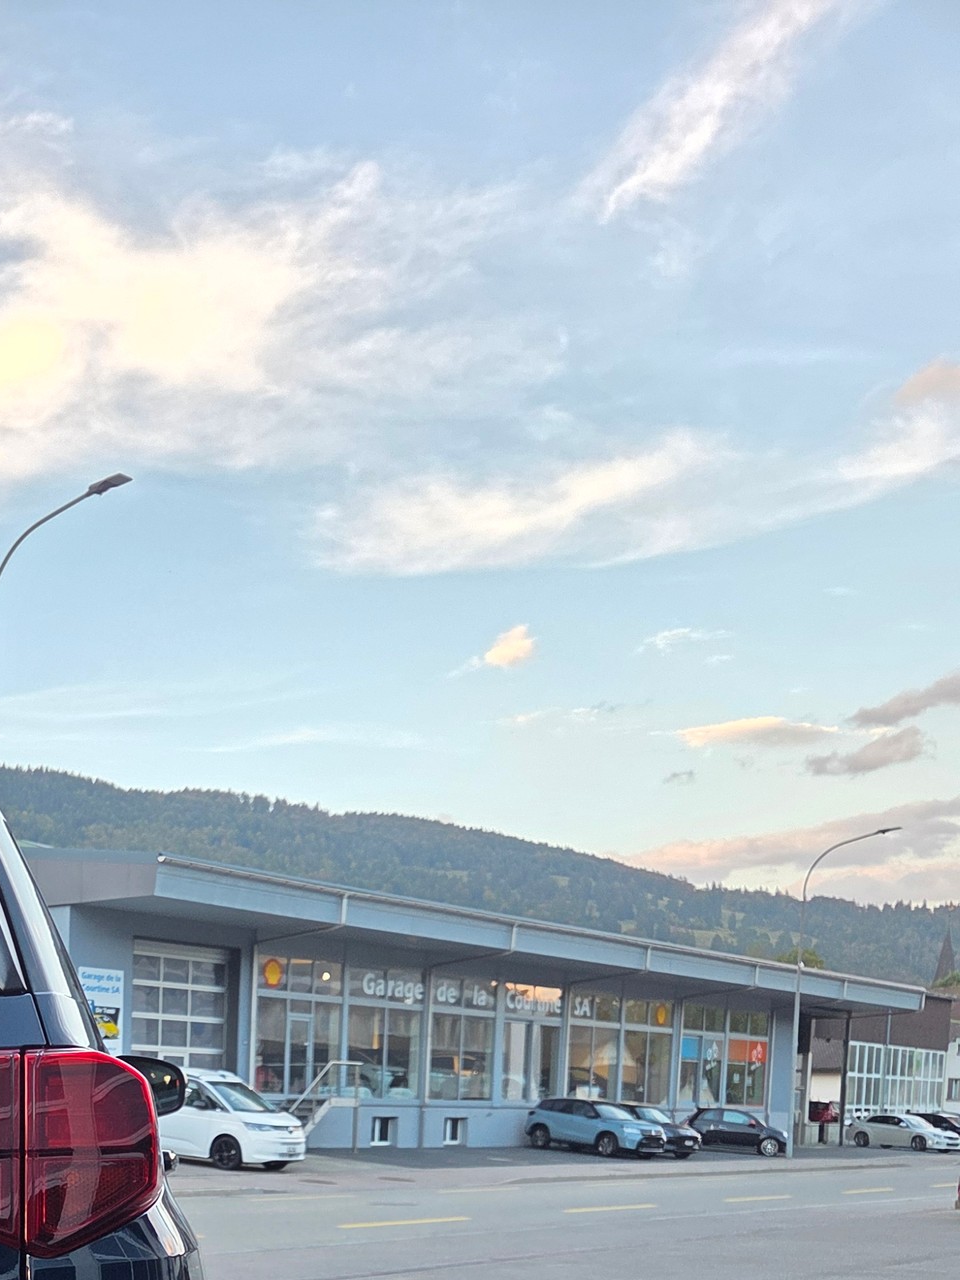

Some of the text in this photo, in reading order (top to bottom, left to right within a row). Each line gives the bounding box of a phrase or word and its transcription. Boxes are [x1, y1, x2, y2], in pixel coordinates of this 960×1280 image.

[81, 971, 105, 983] Garage
[106, 974, 114, 982] de
[362, 973, 424, 1005] Garage
[436, 983, 457, 1004] de
[472, 984, 488, 1006] la
[574, 997, 591, 1017] SA
